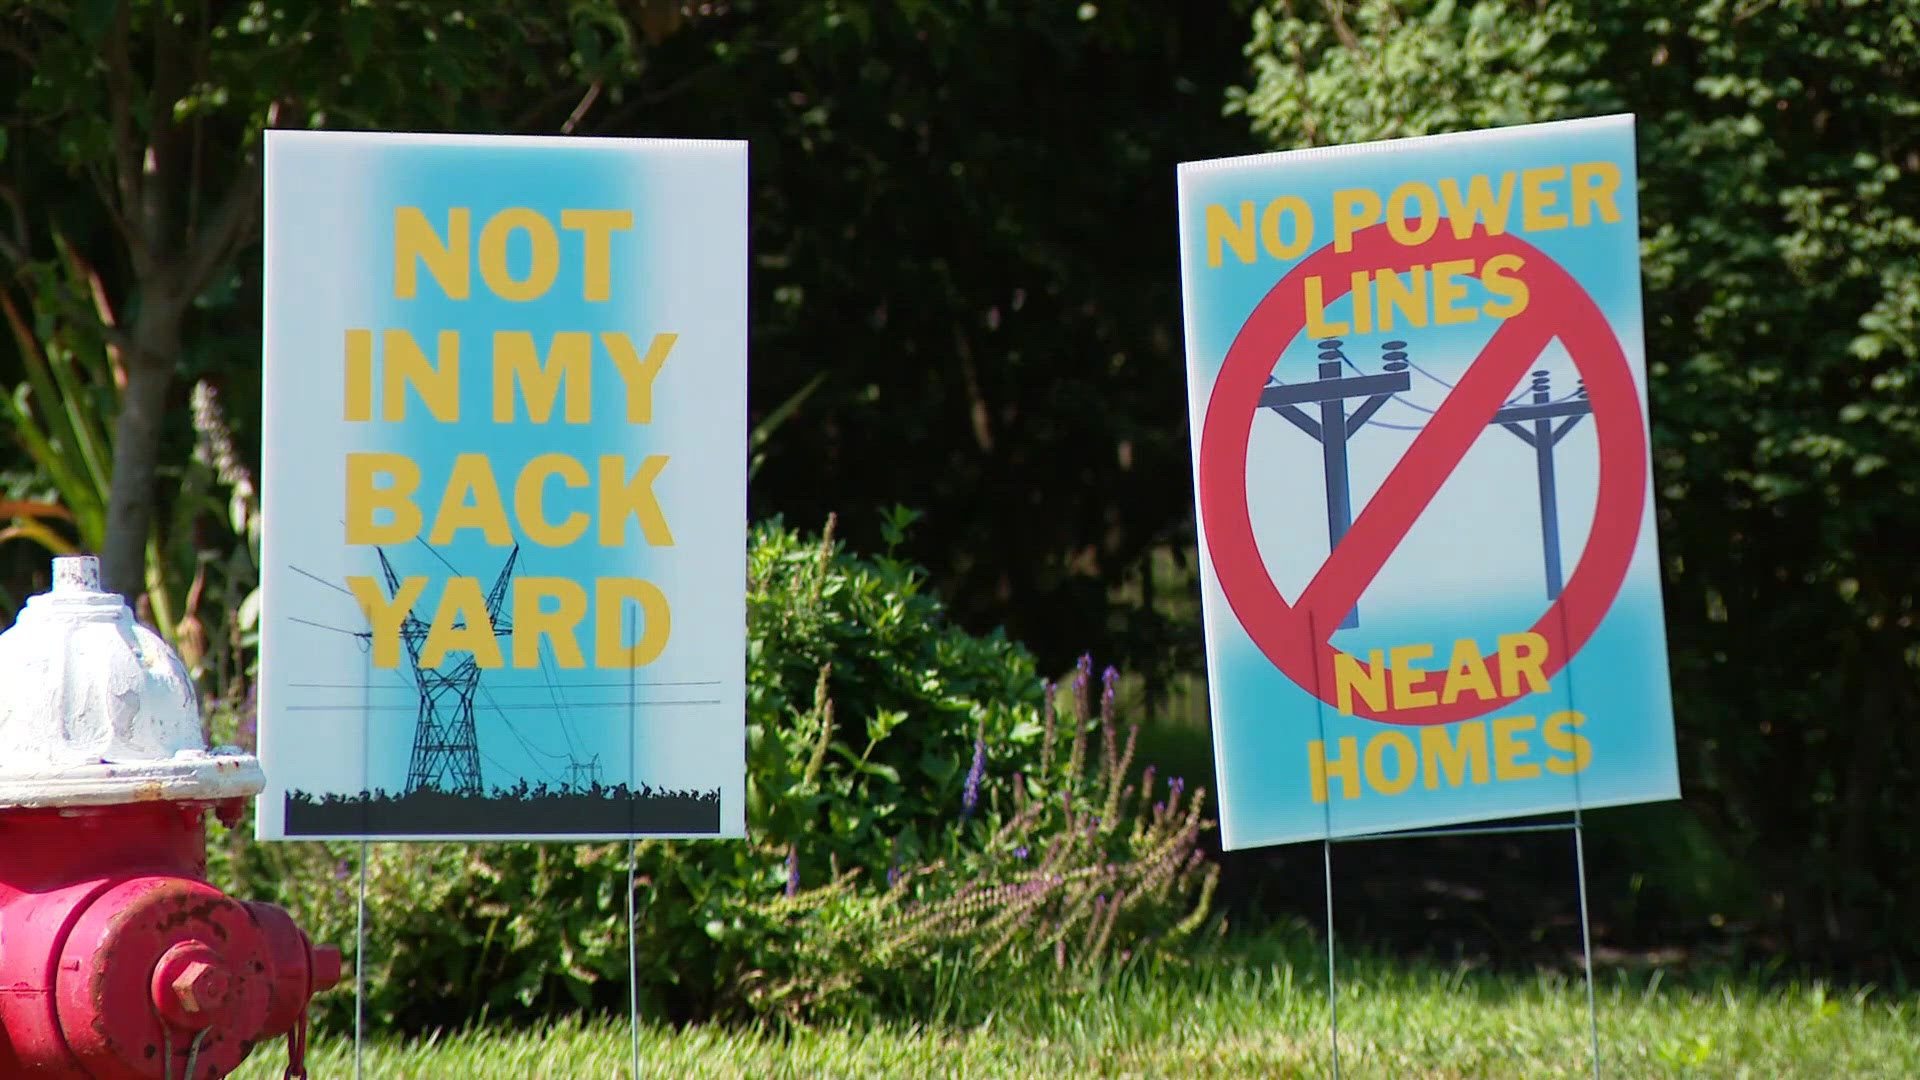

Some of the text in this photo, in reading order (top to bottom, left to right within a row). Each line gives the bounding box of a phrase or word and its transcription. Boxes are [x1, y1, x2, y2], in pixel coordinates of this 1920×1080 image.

[394, 206, 633, 302] NOT
[1205, 160, 1621, 268] NO POWER
[1303, 254, 1530, 341] LINES
[344, 329, 679, 425] IN MY
[345, 453, 675, 547] BACK
[345, 576, 673, 669] YARD
[1333, 630, 1551, 716] NEAR
[1307, 710, 1592, 804] HOMES
